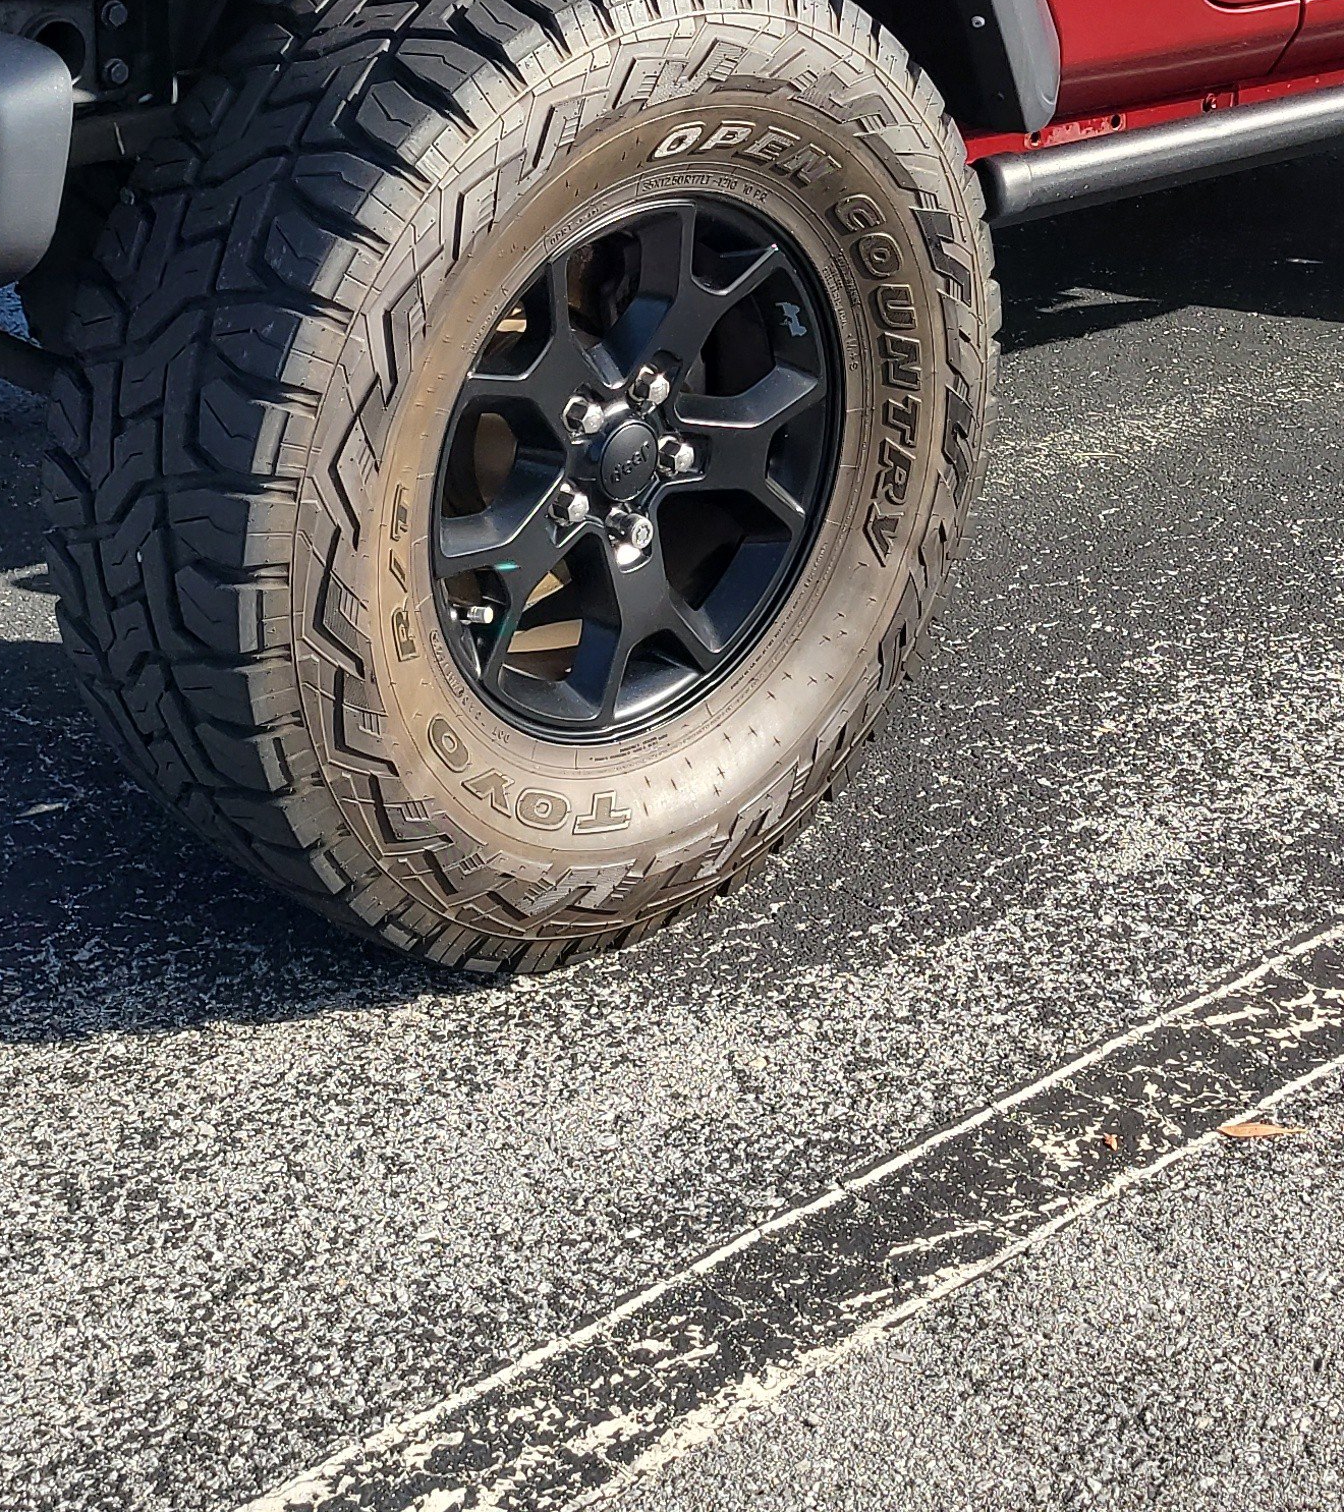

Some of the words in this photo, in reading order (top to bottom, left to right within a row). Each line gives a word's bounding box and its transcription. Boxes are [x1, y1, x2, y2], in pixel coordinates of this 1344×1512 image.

[649, 120, 843, 188] OPEN
[828, 193, 923, 568] COUNTRY
[427, 713, 633, 836] TOYO
